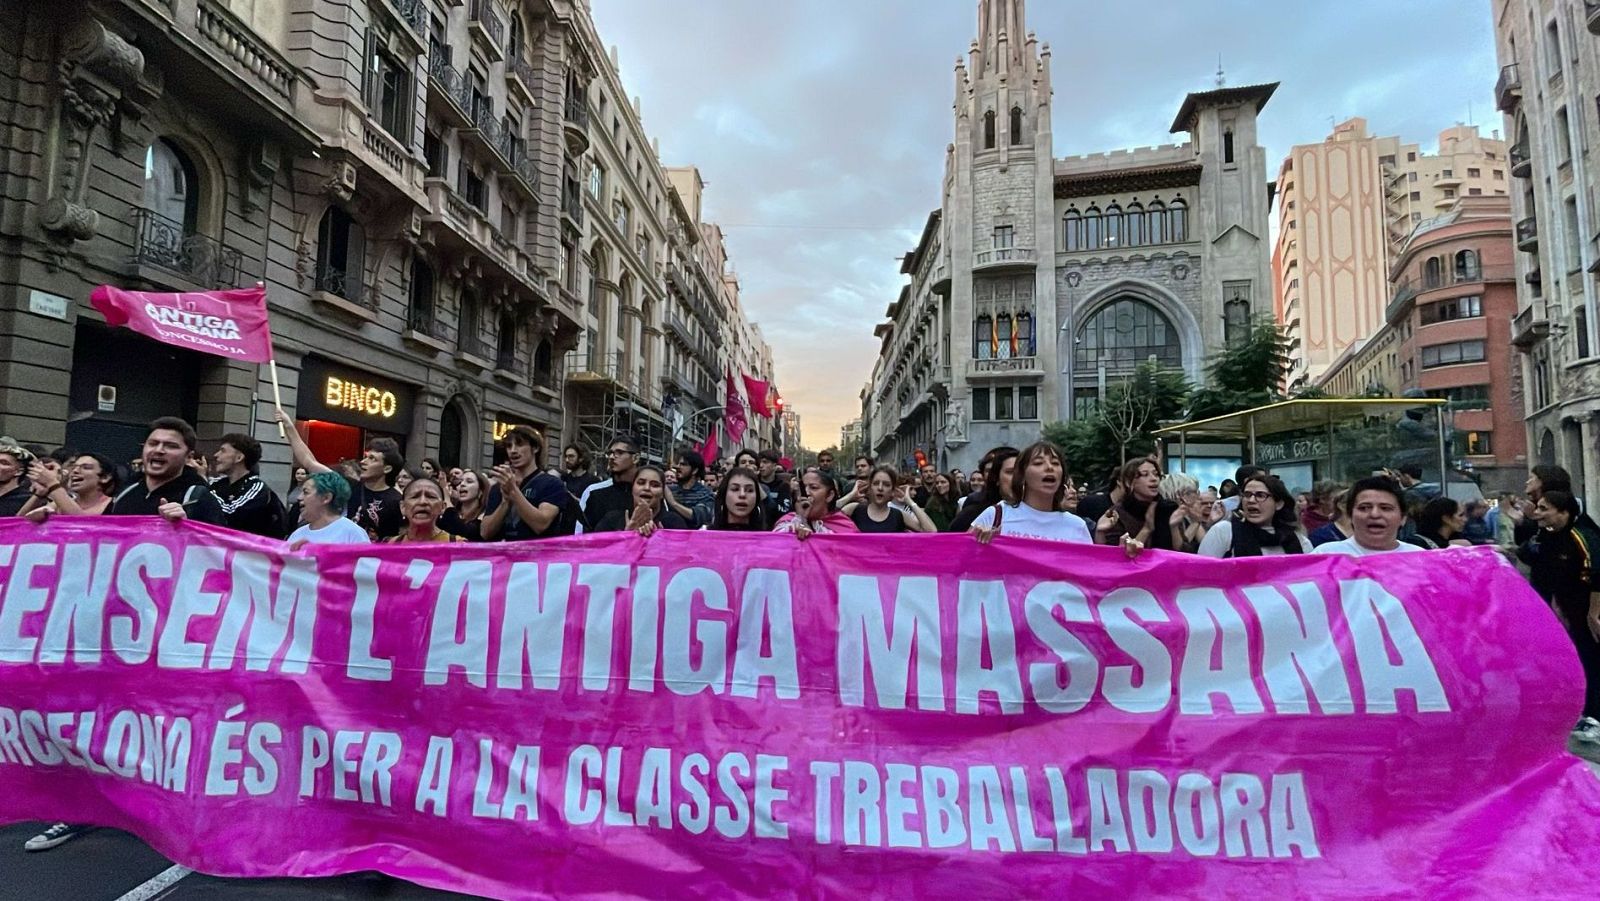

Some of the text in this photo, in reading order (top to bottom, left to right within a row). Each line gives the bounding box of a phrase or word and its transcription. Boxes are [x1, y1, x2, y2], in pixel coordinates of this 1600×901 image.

[326, 376, 396, 417] BINGO
[0, 543, 1451, 714] ENSEM L'ANTIGA MASSANA
[0, 703, 1320, 859] RCELONA ÉS PER A LA CLASSE TREBALLADORA
